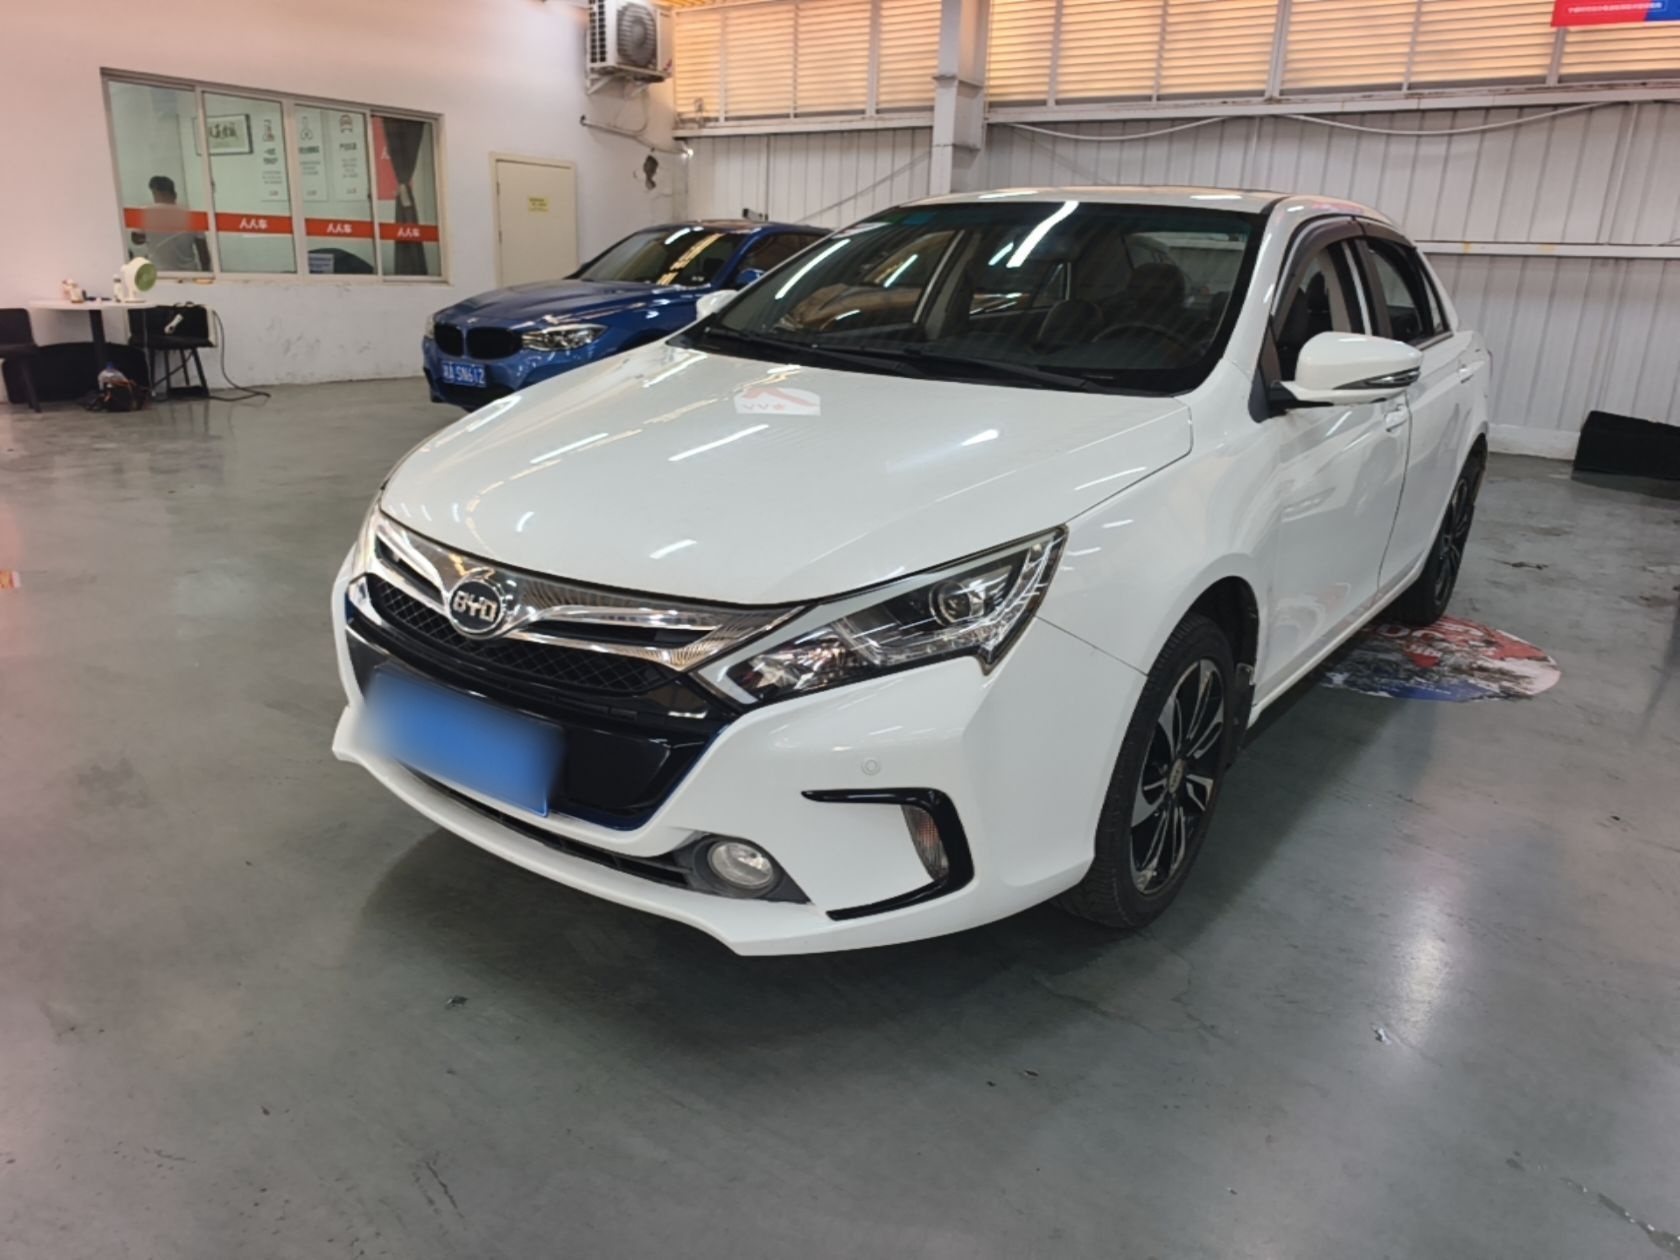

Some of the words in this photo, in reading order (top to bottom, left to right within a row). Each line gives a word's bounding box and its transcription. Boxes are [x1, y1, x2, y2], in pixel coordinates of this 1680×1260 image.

[239, 217, 268, 229] 人人车
[326, 223, 353, 234] 人人车
[396, 228, 421, 238] 人人车
[453, 590, 498, 623] BYD
